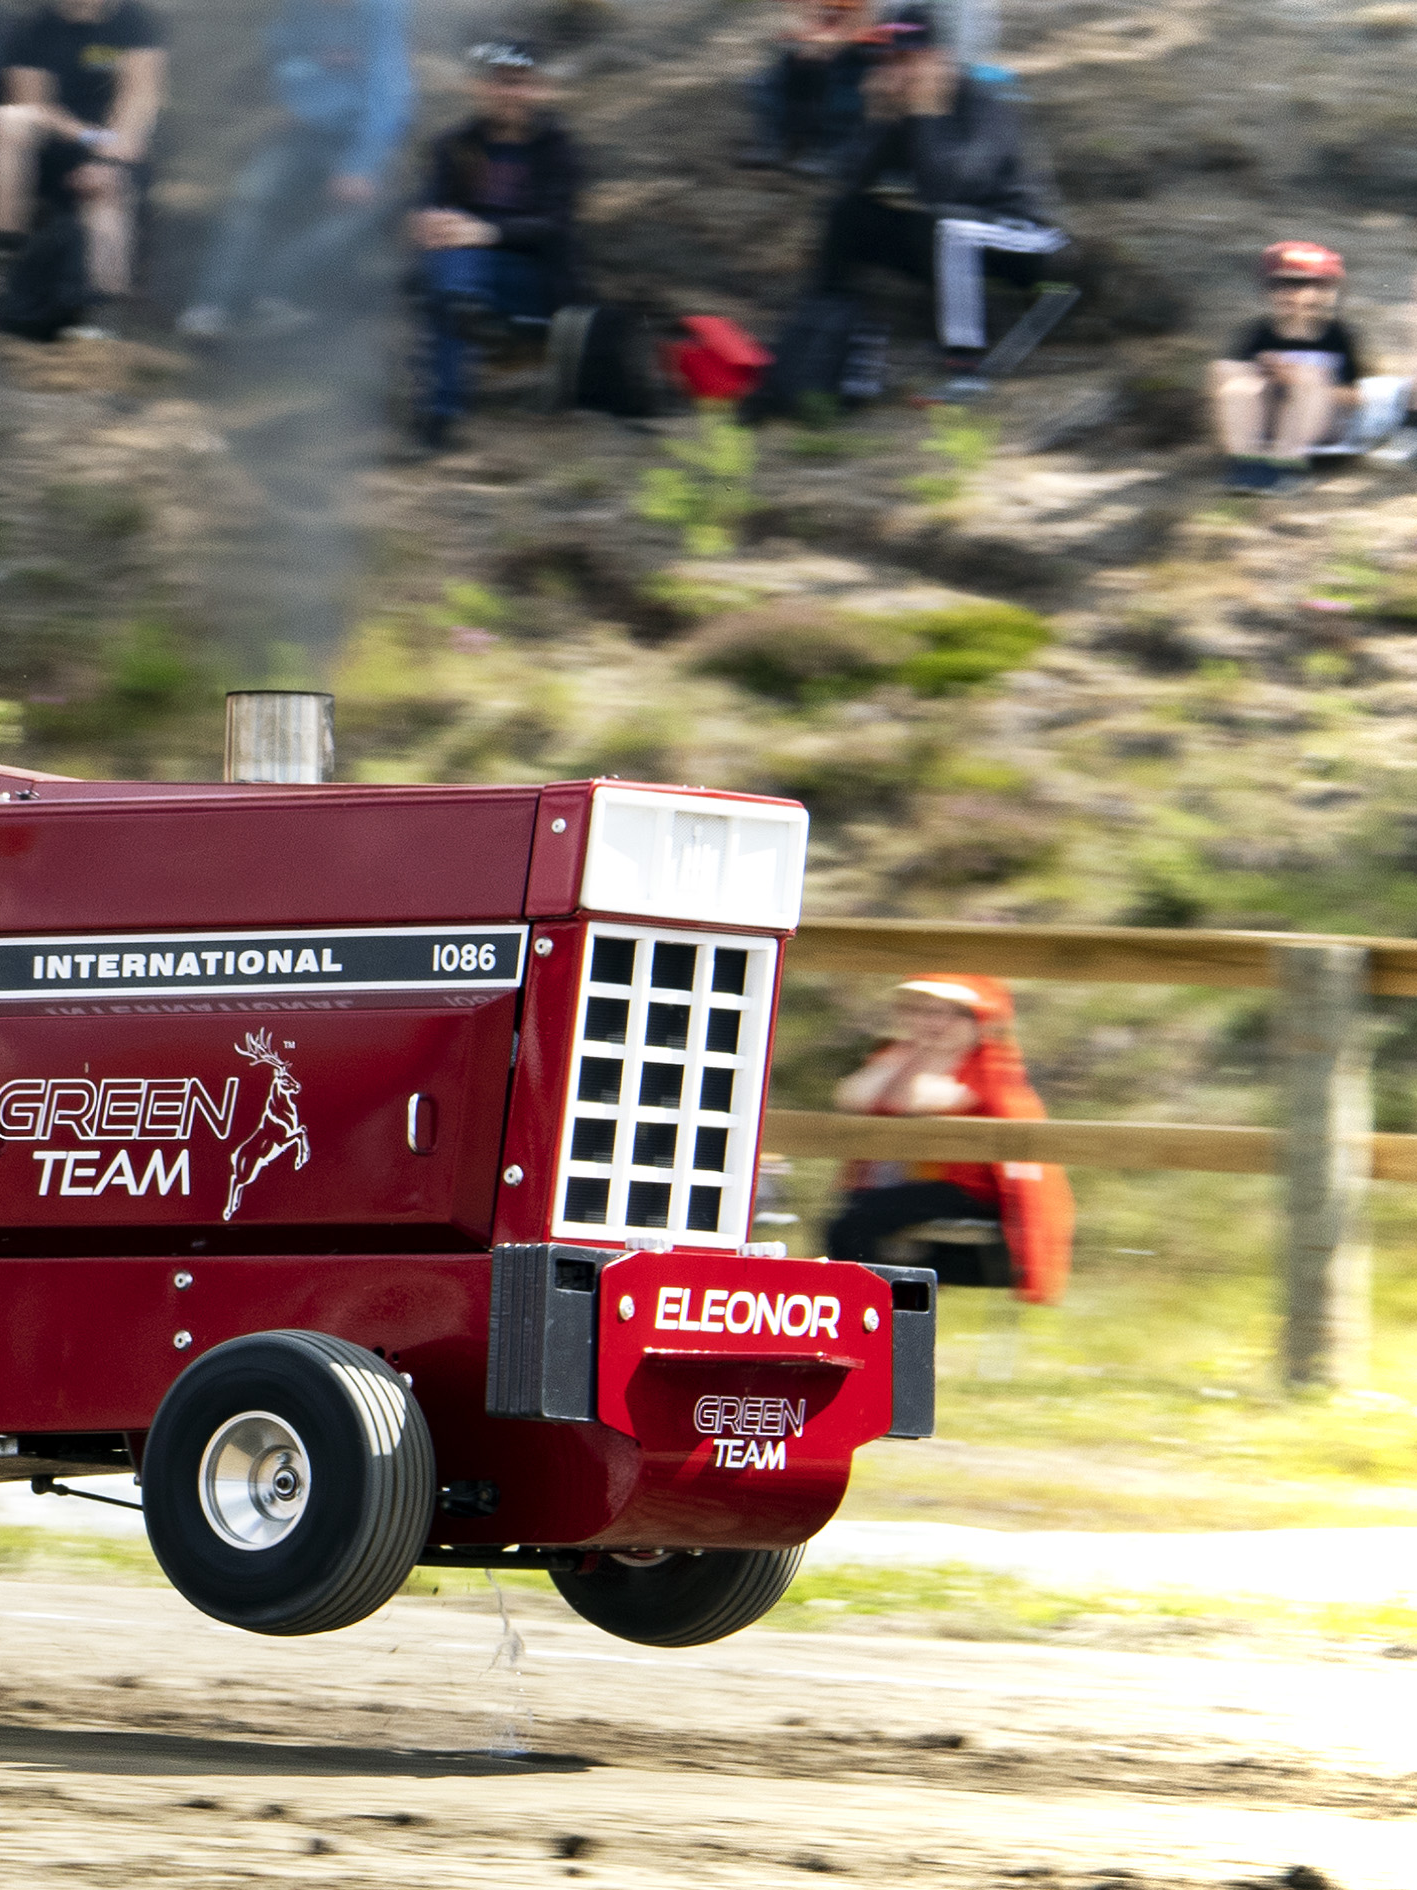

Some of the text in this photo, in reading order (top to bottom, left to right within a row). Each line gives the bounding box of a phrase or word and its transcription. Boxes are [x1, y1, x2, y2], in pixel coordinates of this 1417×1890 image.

[33, 943, 497, 979] INTERNATIONAL 1086
[32, 1149, 190, 1196] TEAM
[654, 1286, 841, 1339] ELEONOR
[693, 1395, 806, 1438] GREEN
[713, 1438, 786, 1470] TEAM
